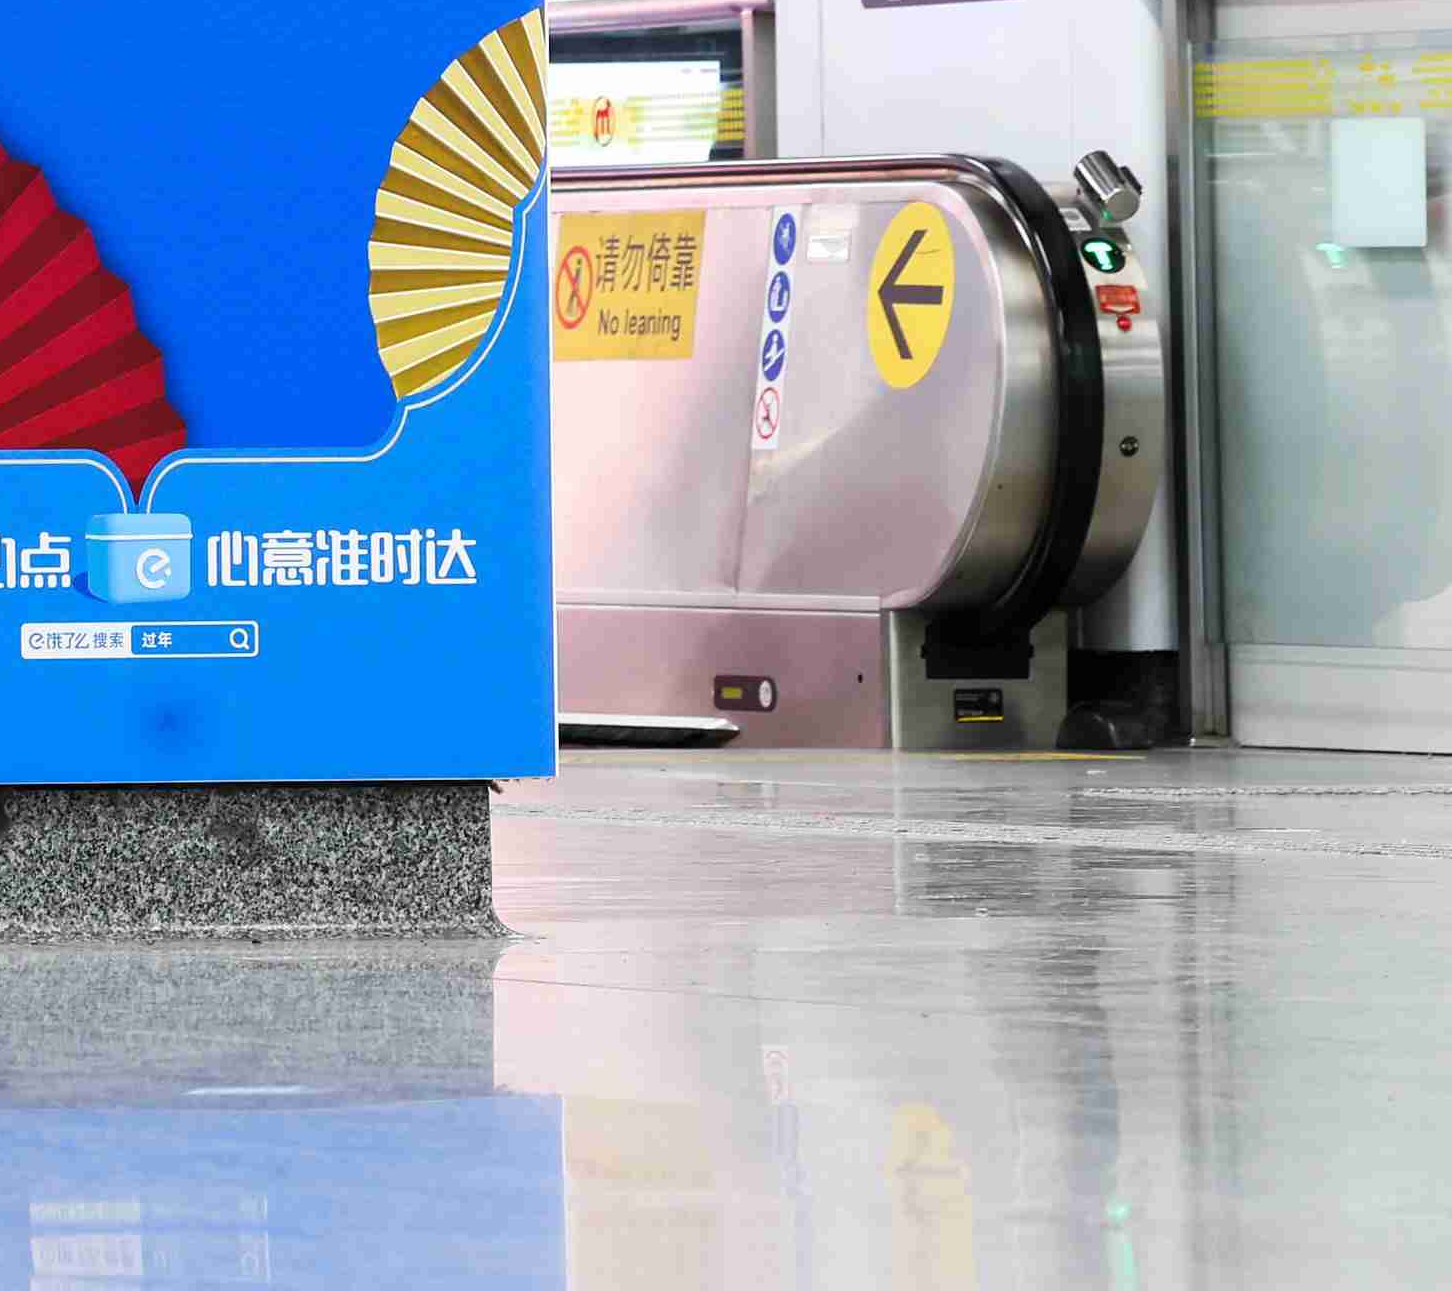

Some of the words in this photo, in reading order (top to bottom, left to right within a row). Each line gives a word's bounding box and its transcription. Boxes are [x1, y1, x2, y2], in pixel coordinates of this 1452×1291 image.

[595, 231, 698, 293] 请勿倚靠
[597, 307, 619, 337] No
[623, 307, 682, 342] leaning
[207, 528, 477, 587] 心意准时达
[140, 630, 173, 650] 过年
